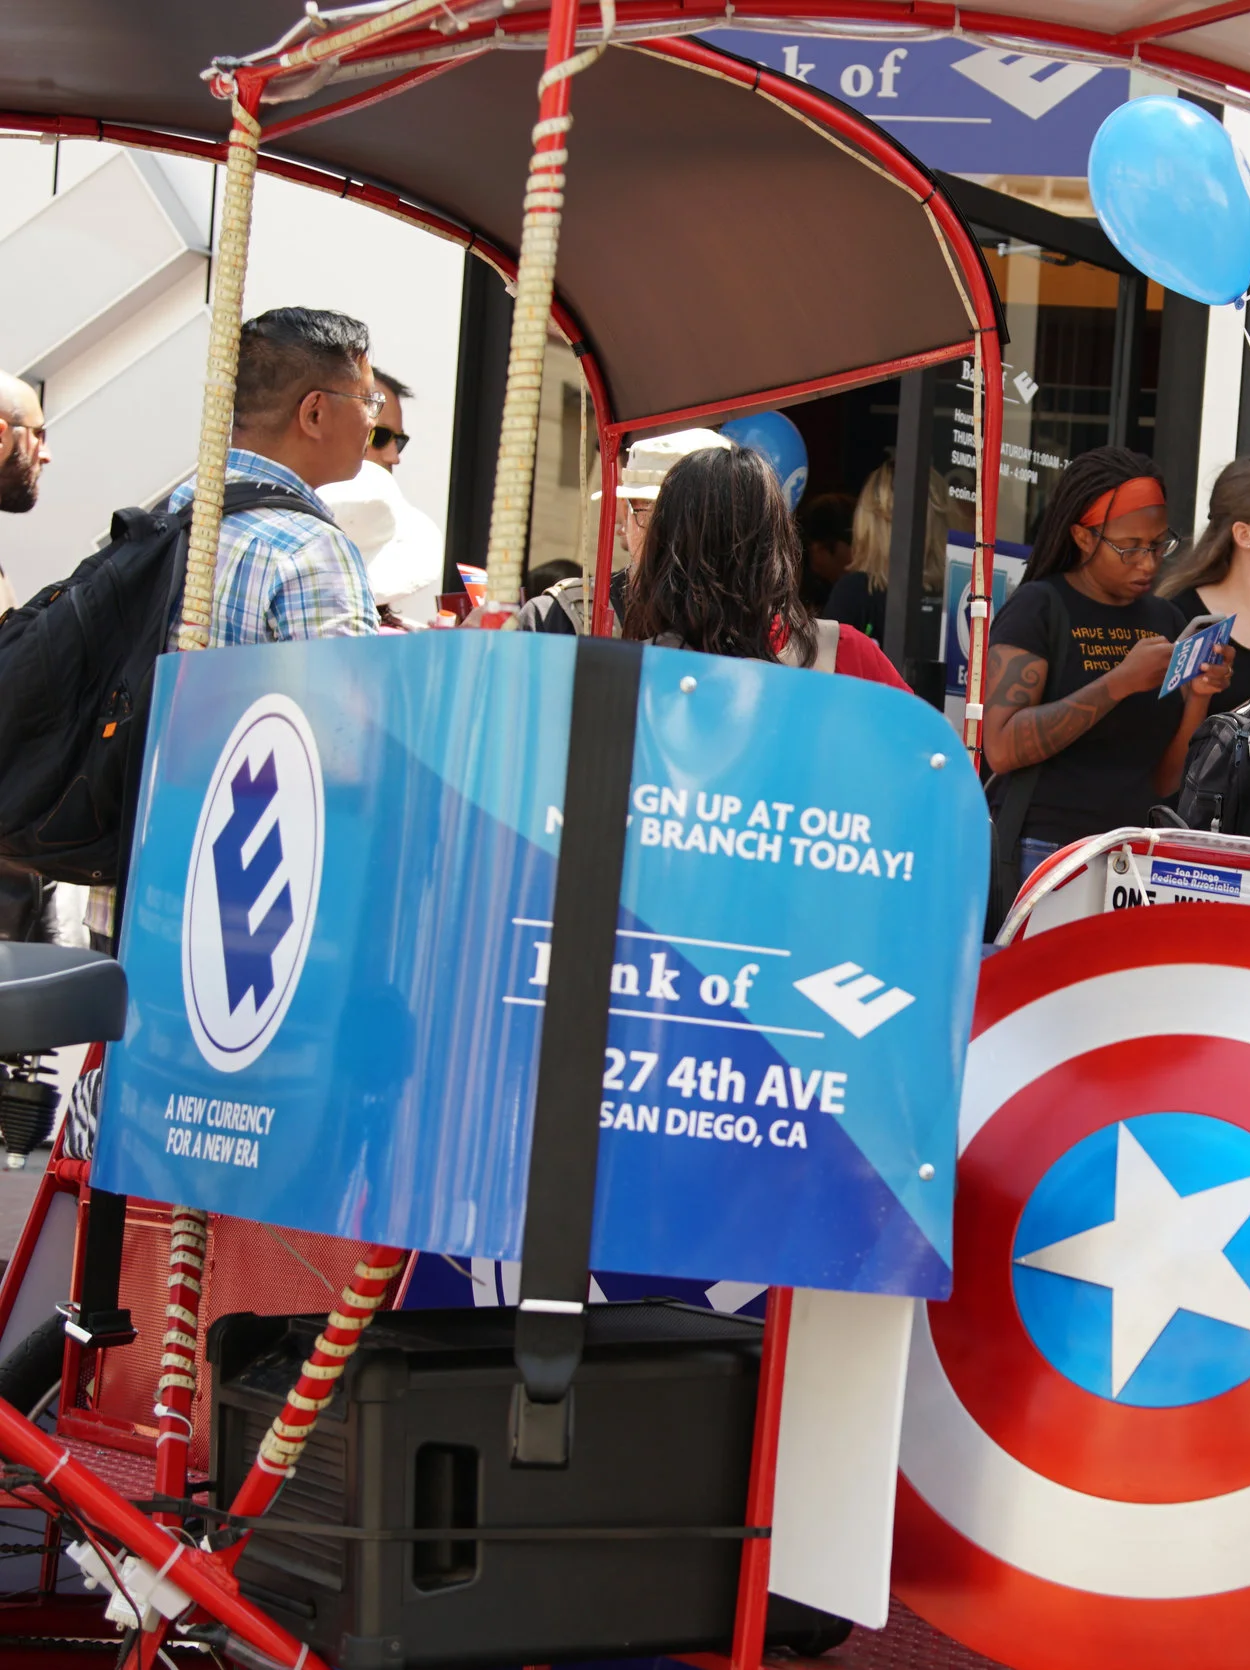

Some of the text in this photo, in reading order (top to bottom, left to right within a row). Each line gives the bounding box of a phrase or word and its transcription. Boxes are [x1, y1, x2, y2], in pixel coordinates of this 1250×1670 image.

[840, 47, 908, 98] of
[1072, 628, 1104, 640] HAVE
[1108, 628, 1132, 641] YOU
[1083, 660, 1111, 672] AND
[695, 791, 742, 824] UP
[747, 799, 795, 832] AT
[799, 807, 871, 844] OUR
[640, 818, 782, 864] BRANCH
[789, 836, 915, 882] TODAY!
[1190, 879, 1240, 894] Association
[1192, 869, 1220, 882] Diego
[699, 963, 760, 1010] of
[666, 1056, 746, 1104] 4th
[755, 1064, 848, 1115] AVE
[164, 1093, 276, 1136] A NEW CURRENCY
[599, 1101, 808, 1149] SAN DIEGO, CA
[165, 1126, 260, 1169] FOR A NEW ERA
